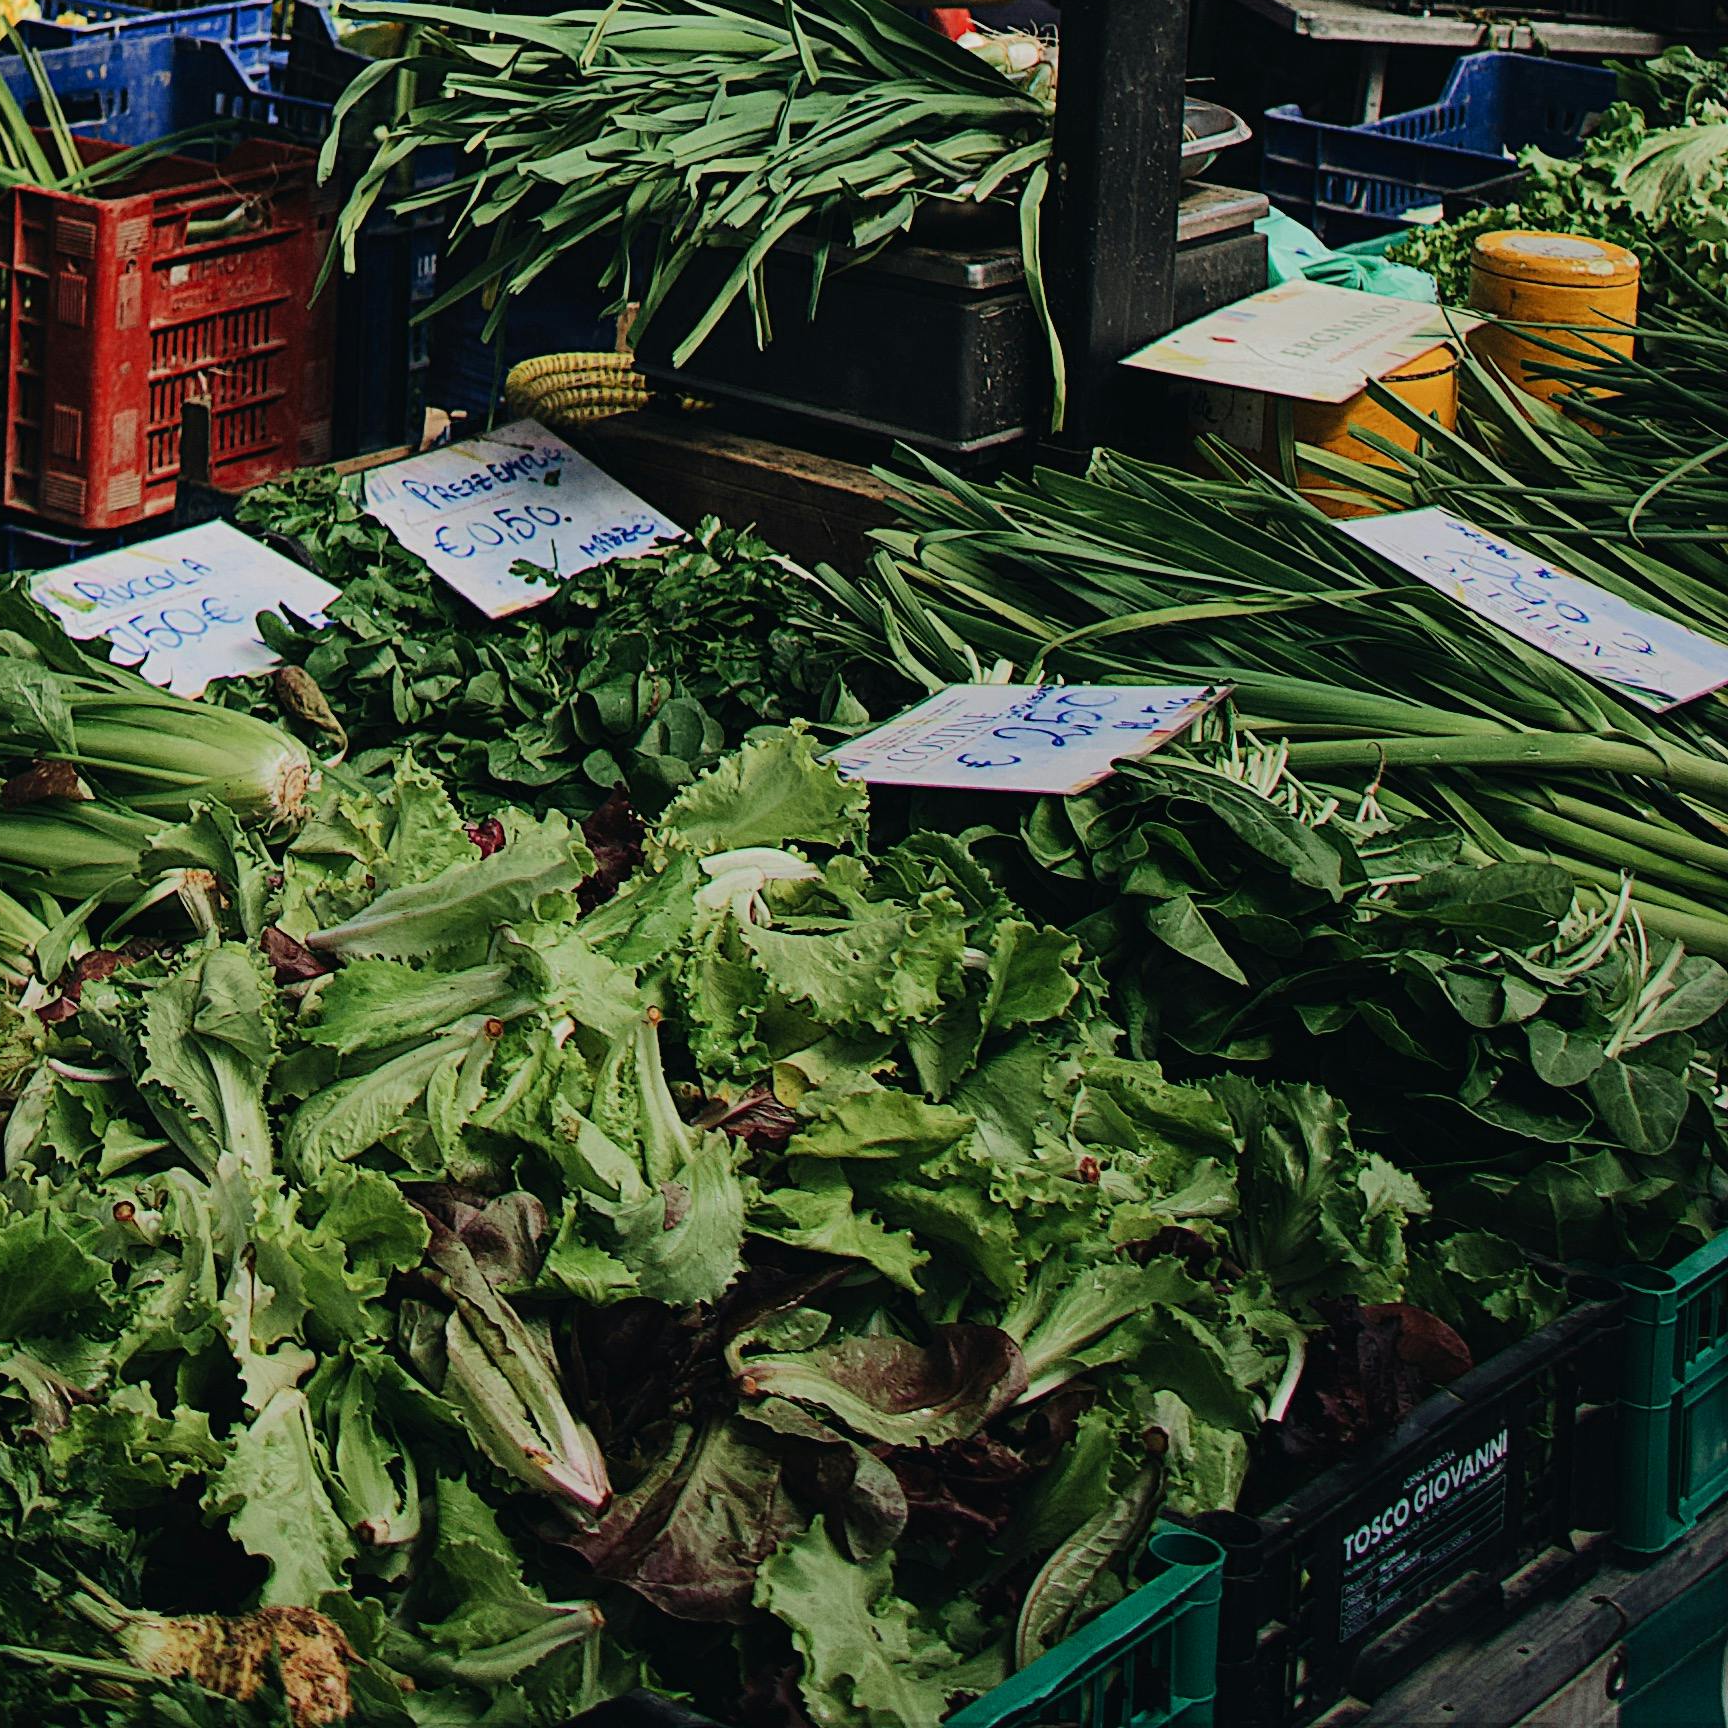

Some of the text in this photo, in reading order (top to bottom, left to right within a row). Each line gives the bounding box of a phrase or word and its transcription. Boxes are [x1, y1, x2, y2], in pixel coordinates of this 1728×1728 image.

[72, 557, 213, 610] RUCOLA
[885, 711, 1003, 763] COSTINE
[1342, 1497, 1411, 1562] TOSCO
[1413, 1427, 1509, 1515] GIOVANNI
